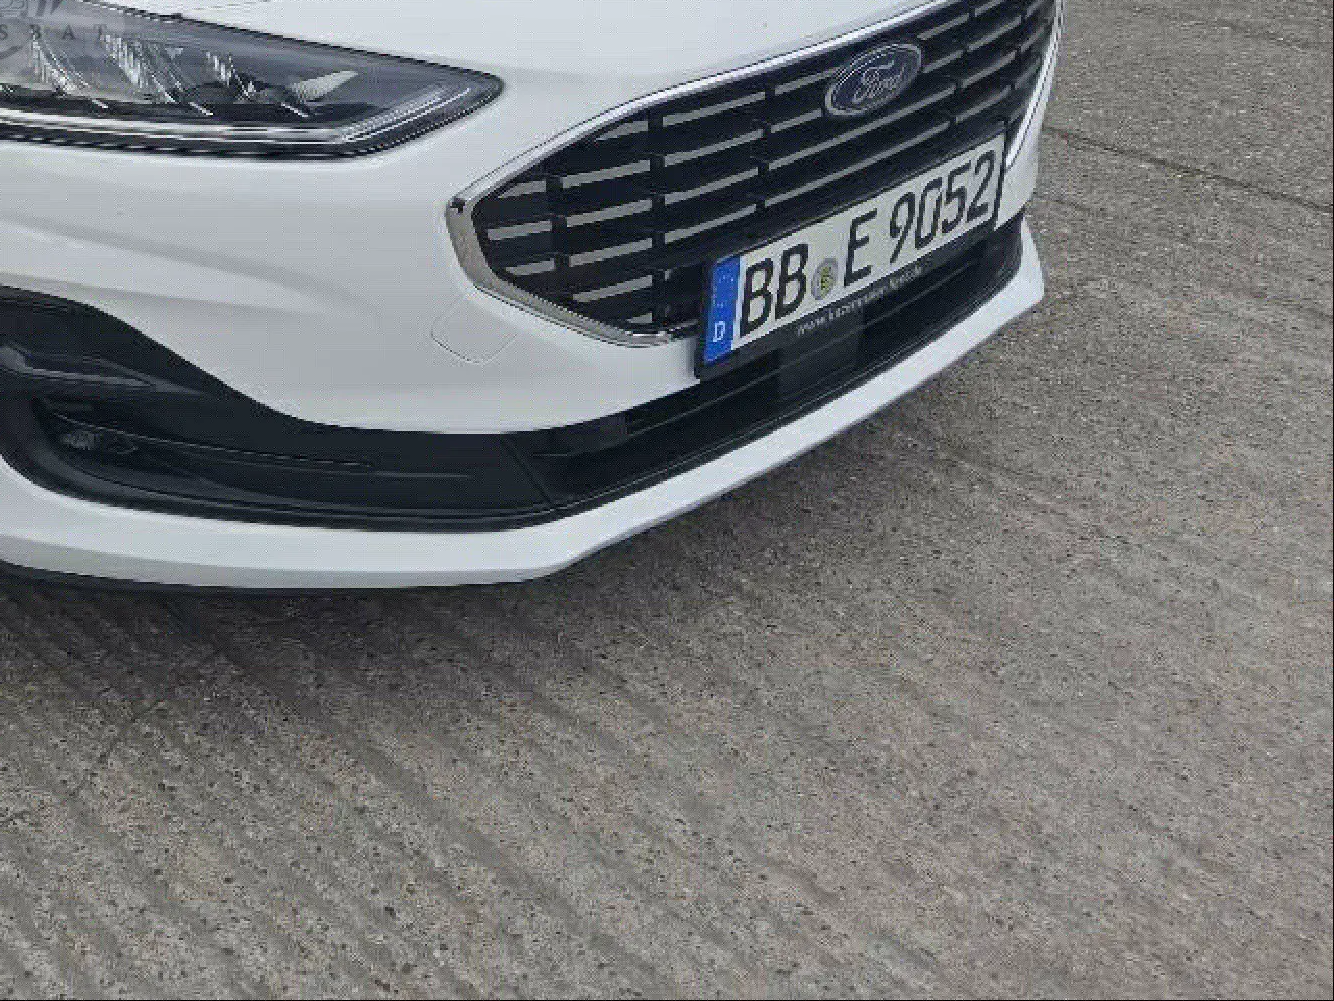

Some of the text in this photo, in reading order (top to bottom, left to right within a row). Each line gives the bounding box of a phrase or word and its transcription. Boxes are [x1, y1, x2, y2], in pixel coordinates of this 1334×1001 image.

[712, 321, 727, 343] D
[740, 243, 808, 337] BB
[844, 208, 878, 287] E
[889, 150, 996, 265] 9052
